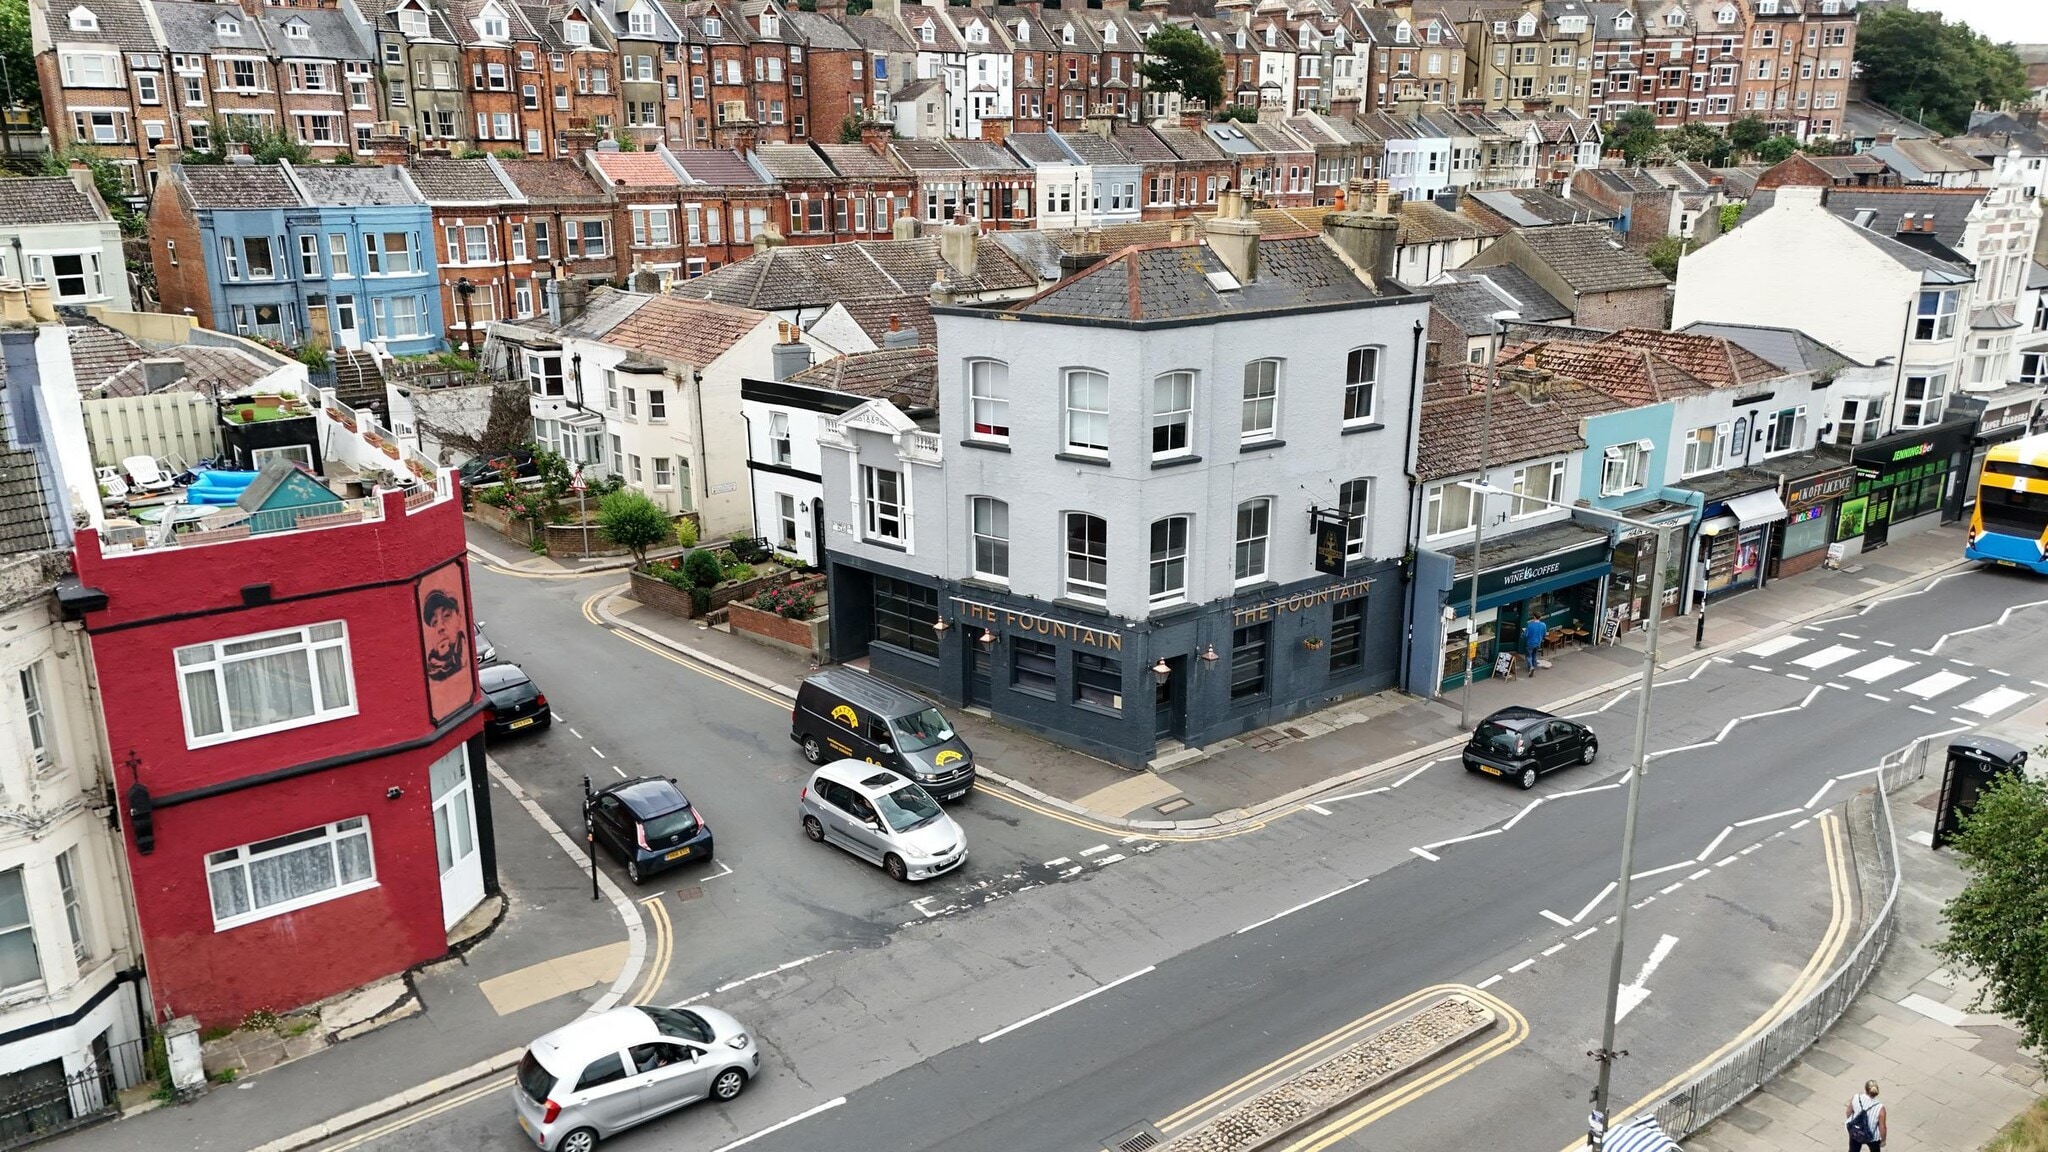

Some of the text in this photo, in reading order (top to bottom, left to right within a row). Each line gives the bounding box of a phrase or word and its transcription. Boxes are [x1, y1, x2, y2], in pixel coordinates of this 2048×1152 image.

[1808, 483, 1823, 497] OFF
[1823, 476, 1852, 494] LICENCE
[1504, 572, 1525, 585] WINE
[1532, 562, 1560, 578] COFFEE
[1233, 578, 1371, 626] THE FOUNTAIN
[959, 601, 1122, 652] THE FOUNTAIN
[834, 707, 857, 723] BATTLE
